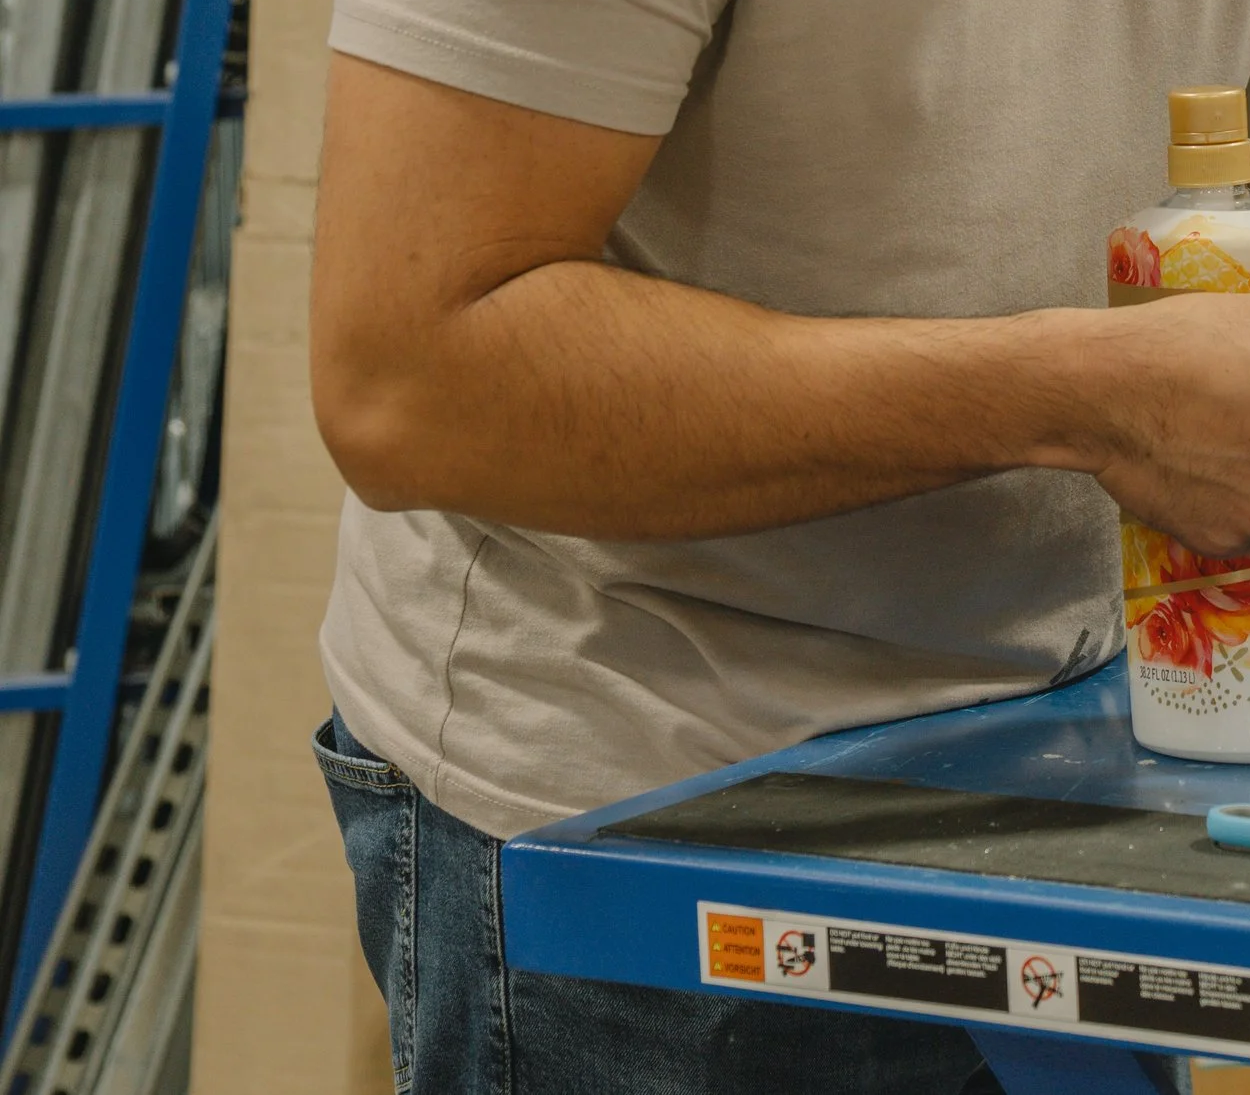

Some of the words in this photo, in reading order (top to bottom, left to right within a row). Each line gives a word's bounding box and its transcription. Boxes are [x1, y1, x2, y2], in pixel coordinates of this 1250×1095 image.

[1152, 668, 1159, 680] FL
[1161, 670, 1170, 681] OZ
[723, 923, 755, 936] CAUTION
[723, 943, 760, 957] ATTENTION
[725, 962, 761, 976] VORSICHT
